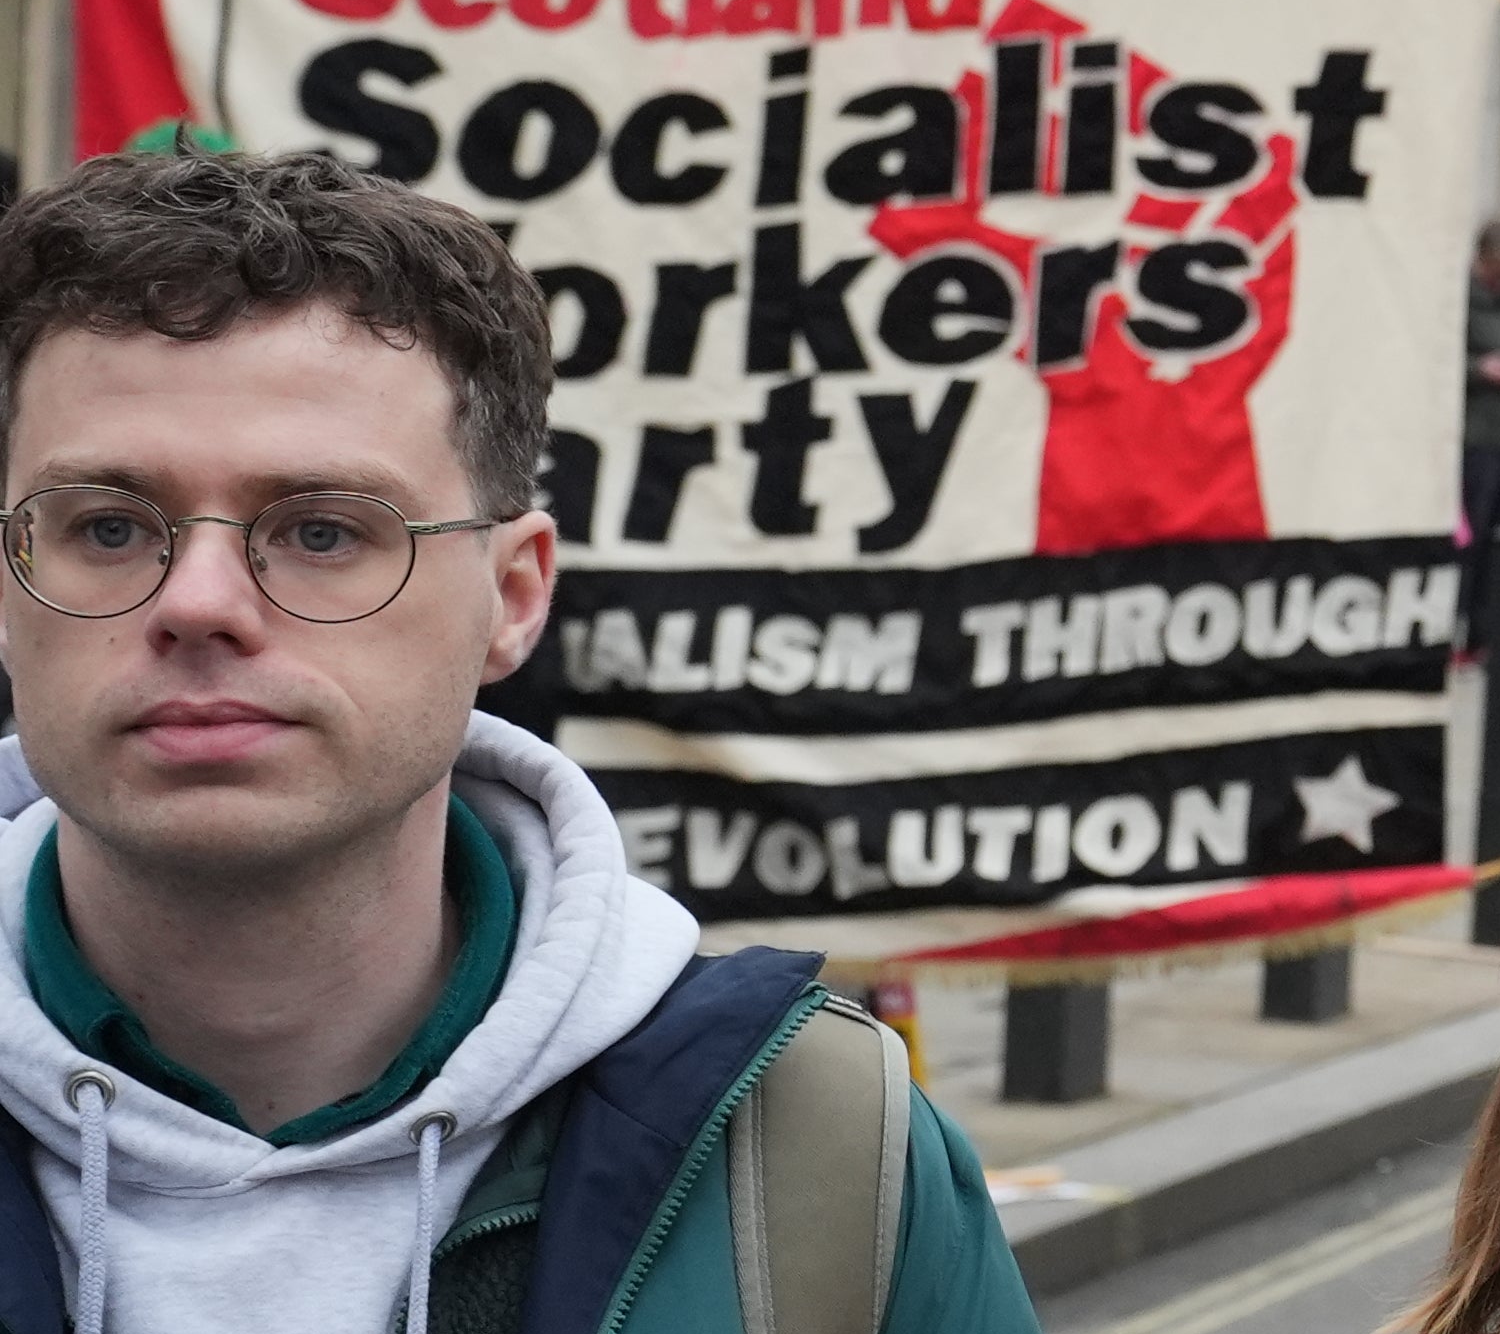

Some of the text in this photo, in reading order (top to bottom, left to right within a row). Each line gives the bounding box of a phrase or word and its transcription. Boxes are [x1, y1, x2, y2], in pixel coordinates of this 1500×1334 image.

[296, 36, 1388, 208] Socialist
[488, 222, 1254, 378] orkers
[532, 374, 978, 555] arty
[960, 565, 1461, 688] THROUGH
[614, 780, 1253, 900] EVOLUTION
